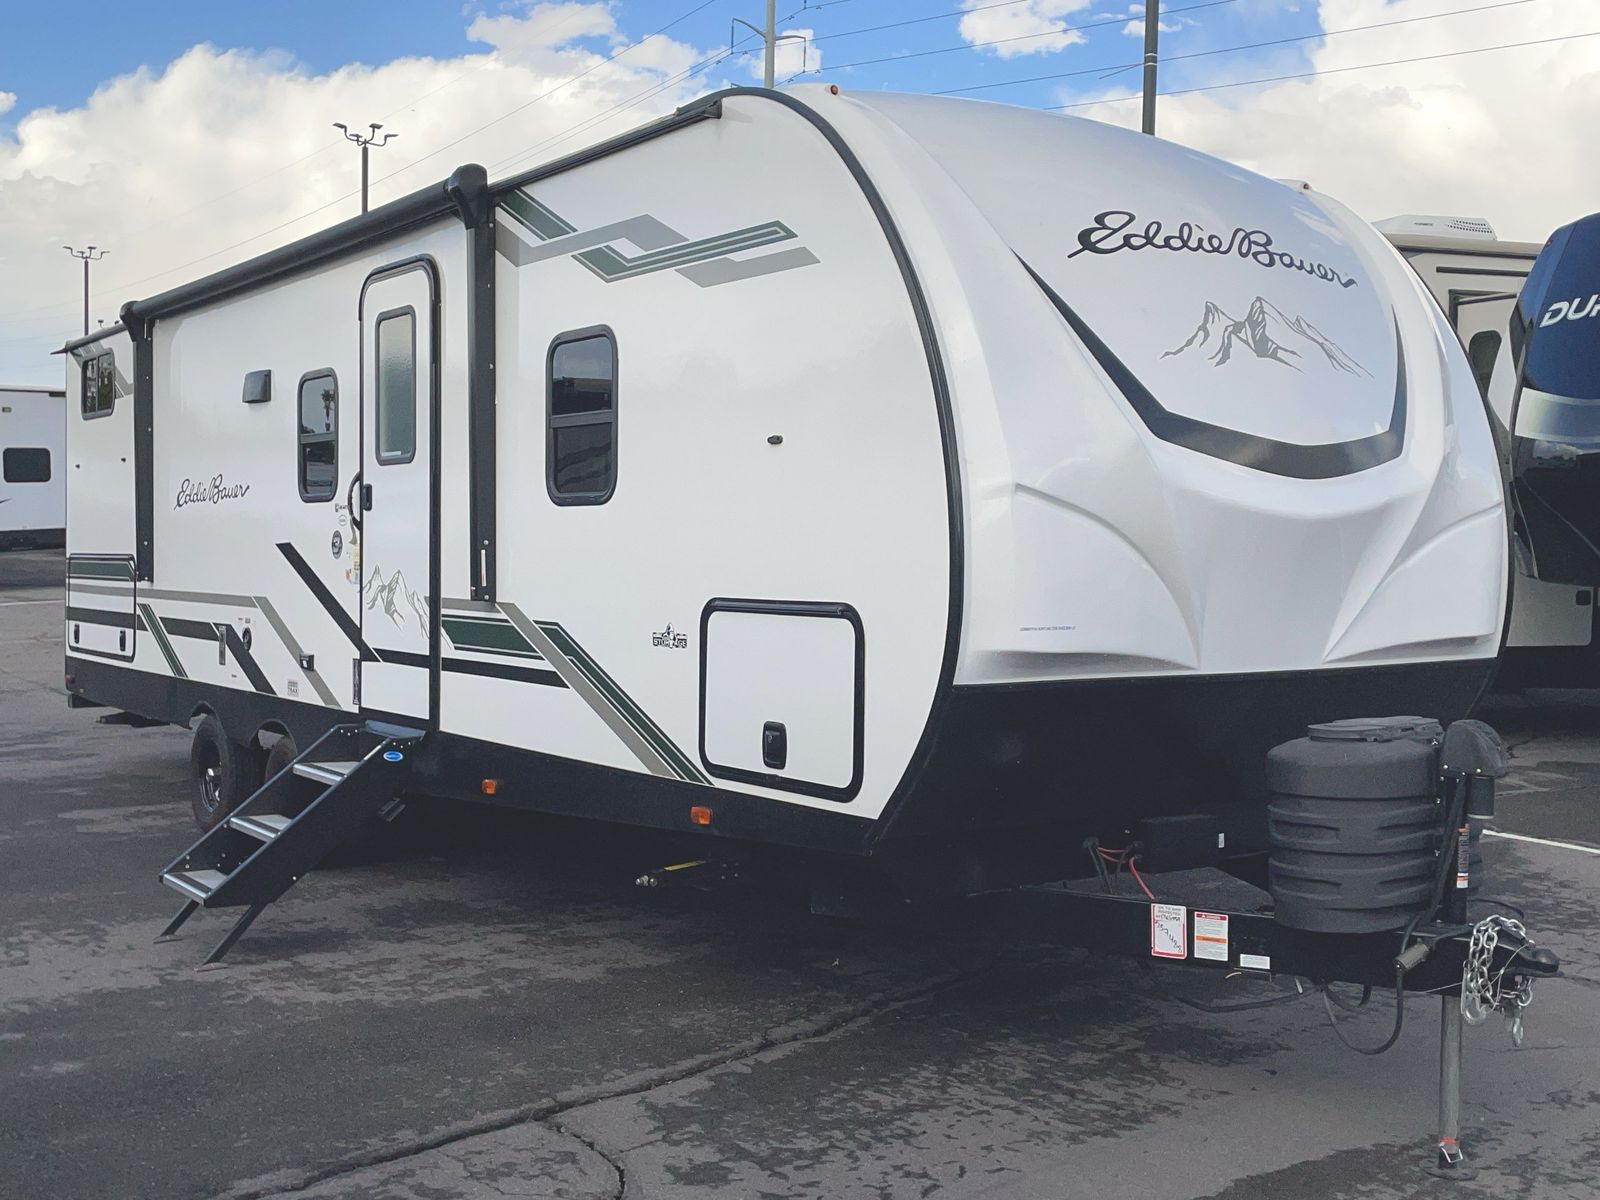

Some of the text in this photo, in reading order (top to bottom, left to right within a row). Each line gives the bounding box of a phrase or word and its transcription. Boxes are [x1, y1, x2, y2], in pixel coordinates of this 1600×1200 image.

[1067, 210, 1358, 288] Eddie Bauer
[173, 473, 250, 511] Eddie Bauer
